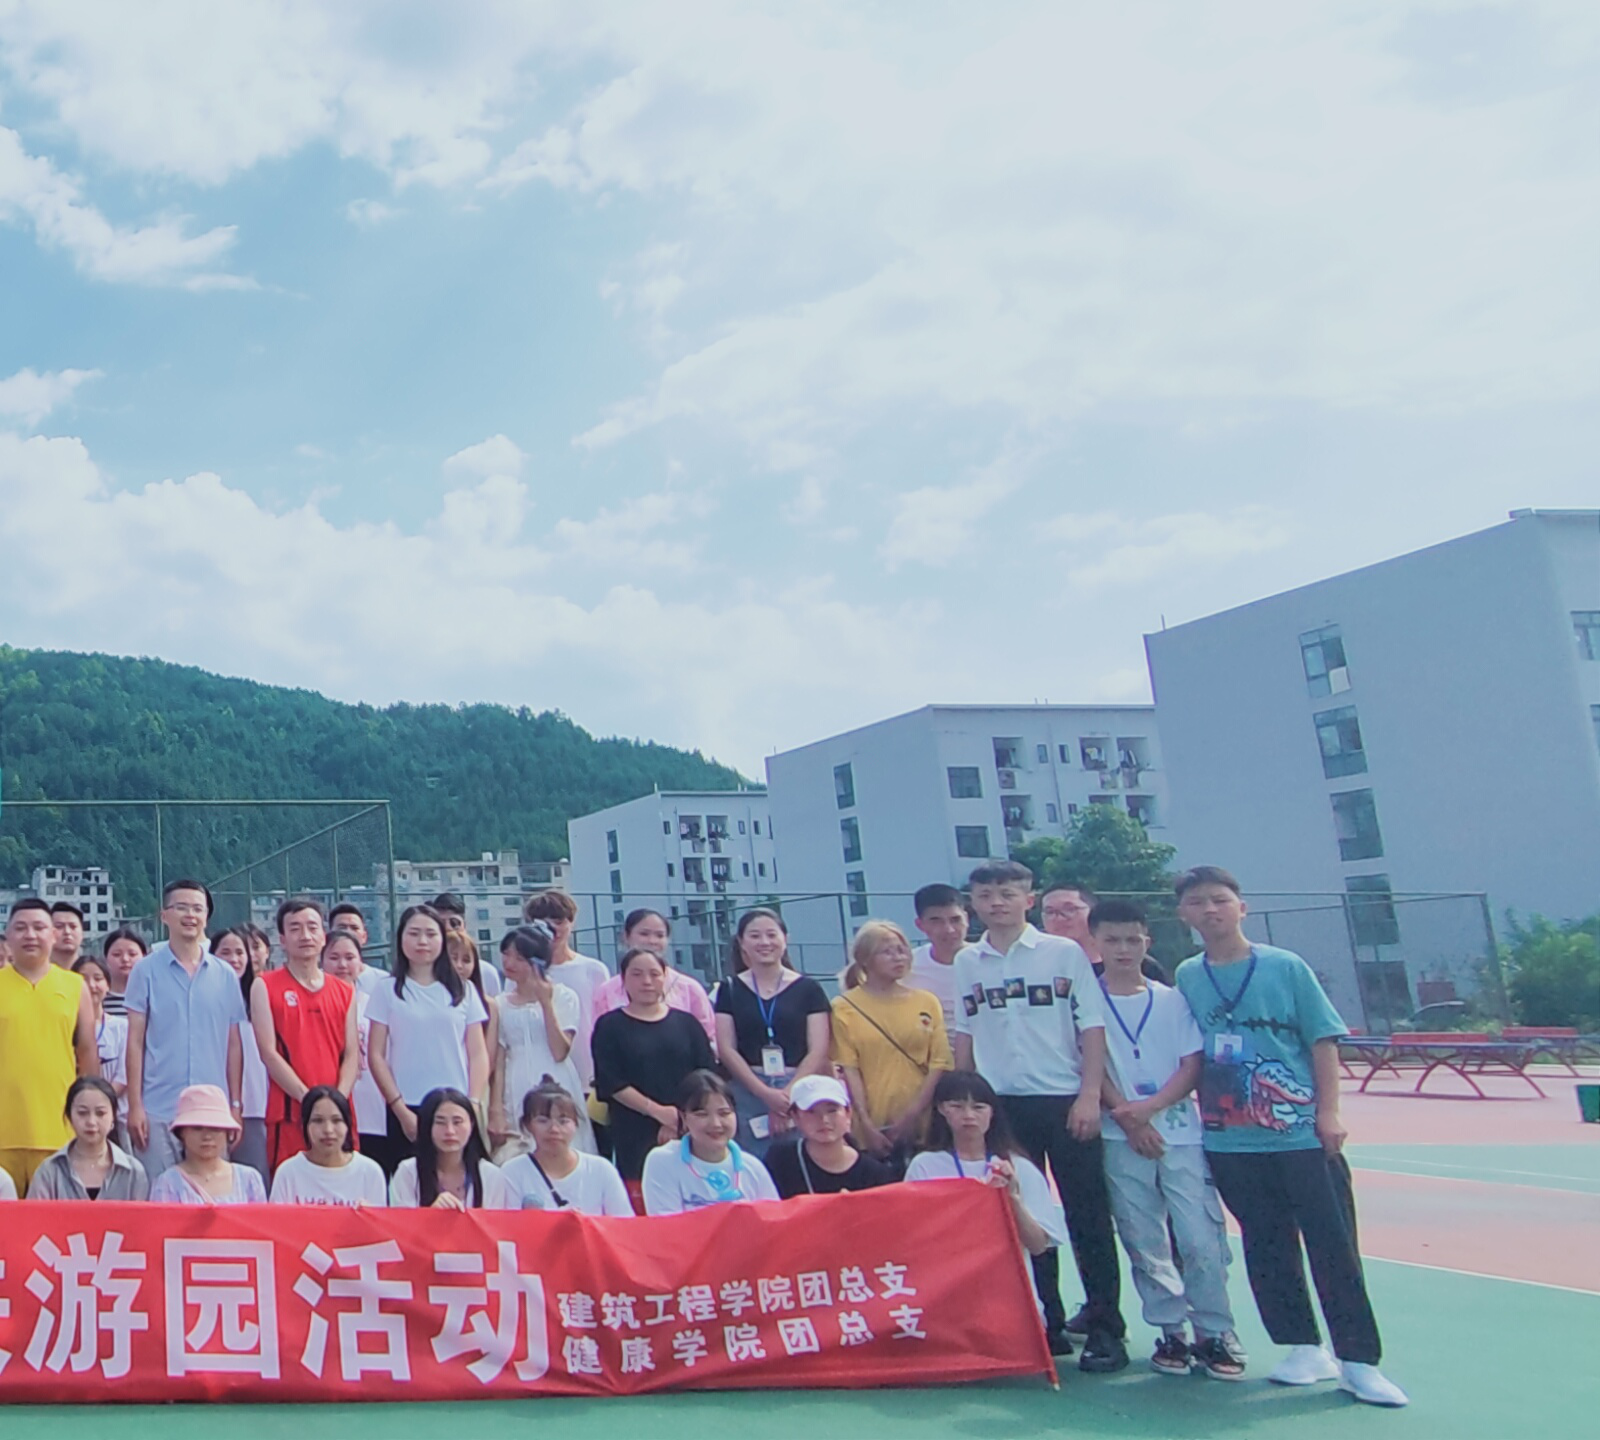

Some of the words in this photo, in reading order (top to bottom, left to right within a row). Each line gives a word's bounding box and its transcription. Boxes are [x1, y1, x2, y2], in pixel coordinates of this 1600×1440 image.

[557, 1261, 917, 1331] 建筑工程学院团总支
[561, 1305, 928, 1374] 健康学院团总支
